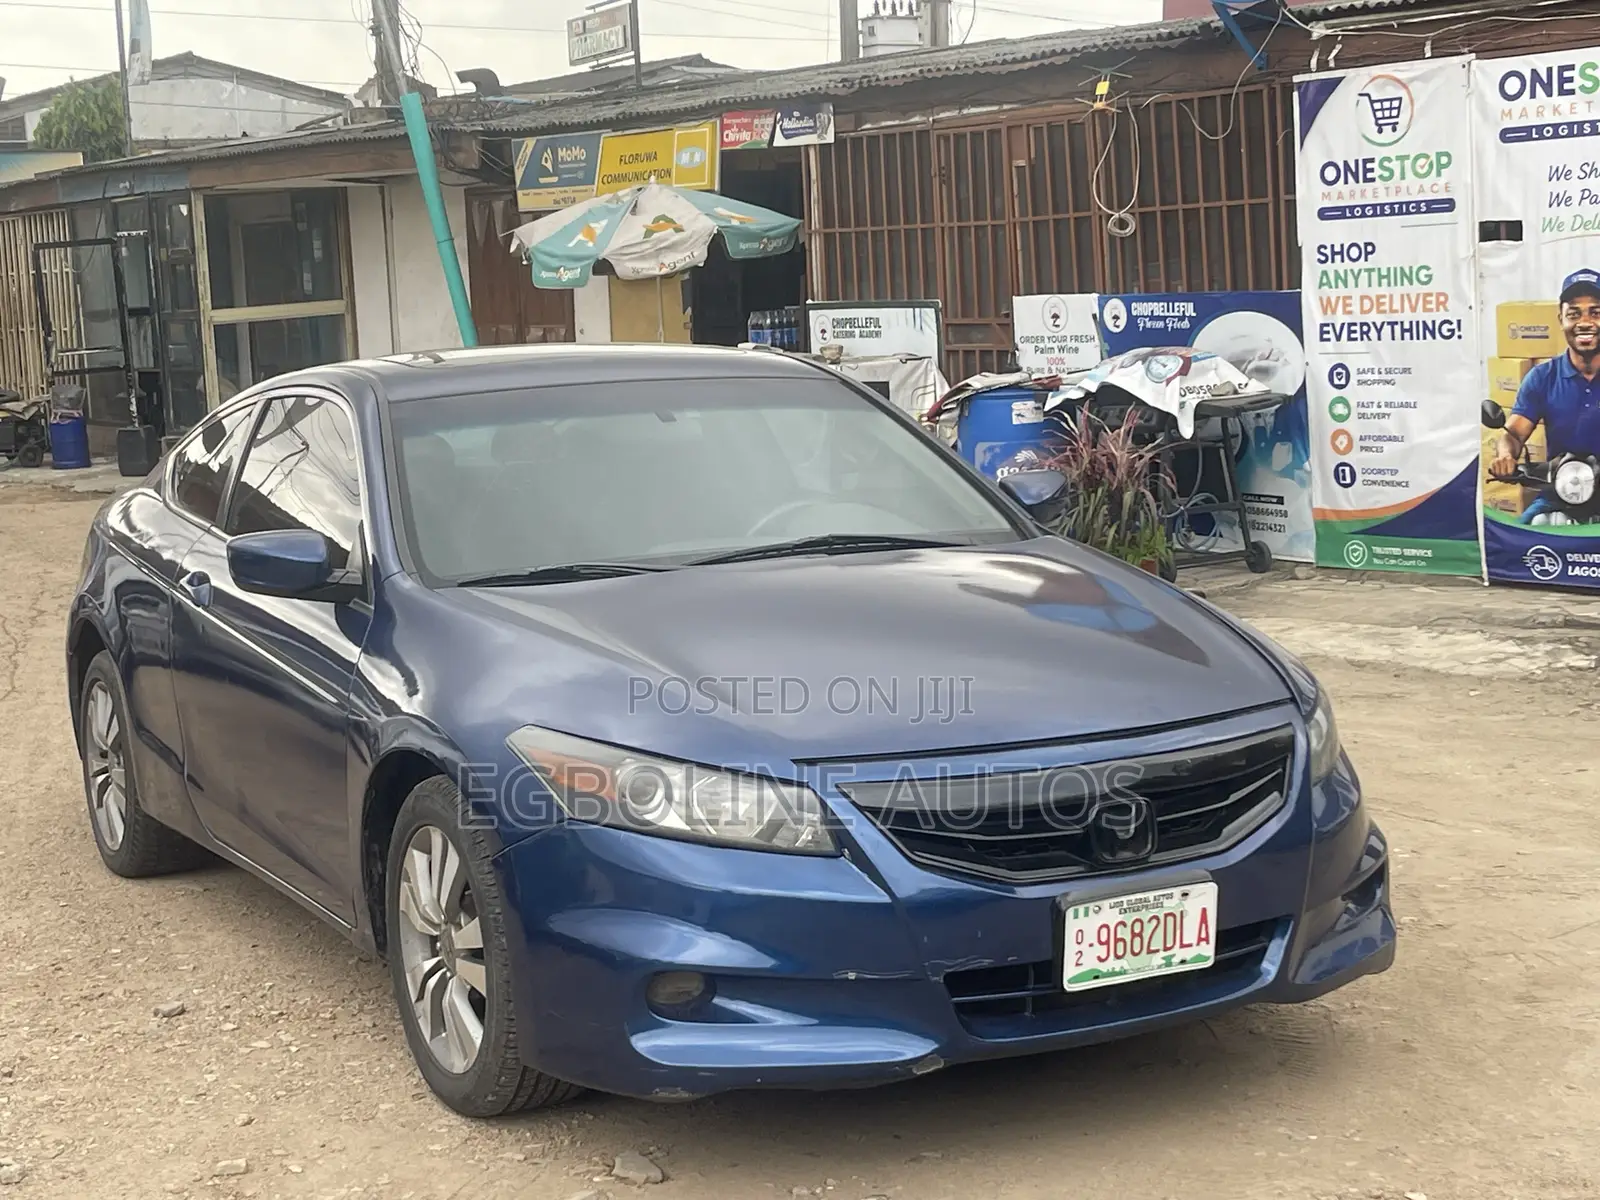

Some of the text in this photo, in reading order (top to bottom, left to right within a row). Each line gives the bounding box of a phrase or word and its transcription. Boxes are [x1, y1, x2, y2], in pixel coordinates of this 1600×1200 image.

[1500, 101, 1594, 121] MARKET
[558, 146, 586, 162] MoMo
[619, 150, 658, 166] FLORUWA
[1319, 151, 1453, 187] ONESTOP
[1548, 164, 1572, 182] We
[1321, 182, 1453, 202] MARKETPLACE
[1548, 190, 1573, 208] We
[1345, 202, 1428, 217] LOGISTICS
[1542, 215, 1565, 233] We
[1316, 241, 1377, 265] SHOP
[1318, 264, 1433, 290] ANYTHING
[1131, 301, 1197, 317] CHOPBELLEFUL
[1319, 292, 1449, 316] WE DELIVER
[831, 316, 882, 329] CHOPBELLEFUL
[832, 329, 882, 339] CATERING ACADEMY
[1318, 318, 1463, 343] EVERYTHING!
[1019, 334, 1096, 345] ORDER YOUR FRESH
[1034, 344, 1080, 355] Palm Wine
[1046, 356, 1066, 366] 100%
[1356, 367, 1376, 375] SAFE
[1384, 367, 1412, 375] SECURE
[1356, 379, 1396, 387] SHOPPING
[1356, 401, 1375, 409] FAST
[1384, 401, 1418, 409] RELIABLE
[1357, 412, 1392, 420] DELIVERY
[1358, 434, 1405, 443] AFFORDABLE
[1360, 445, 1384, 454] PRICES
[1361, 467, 1399, 476] DOORSTEP
[1361, 479, 1410, 488] CONVENIENCE
[1371, 546, 1433, 557] TRUSTED SERVICE
[1397, 558, 1416, 566] Count
